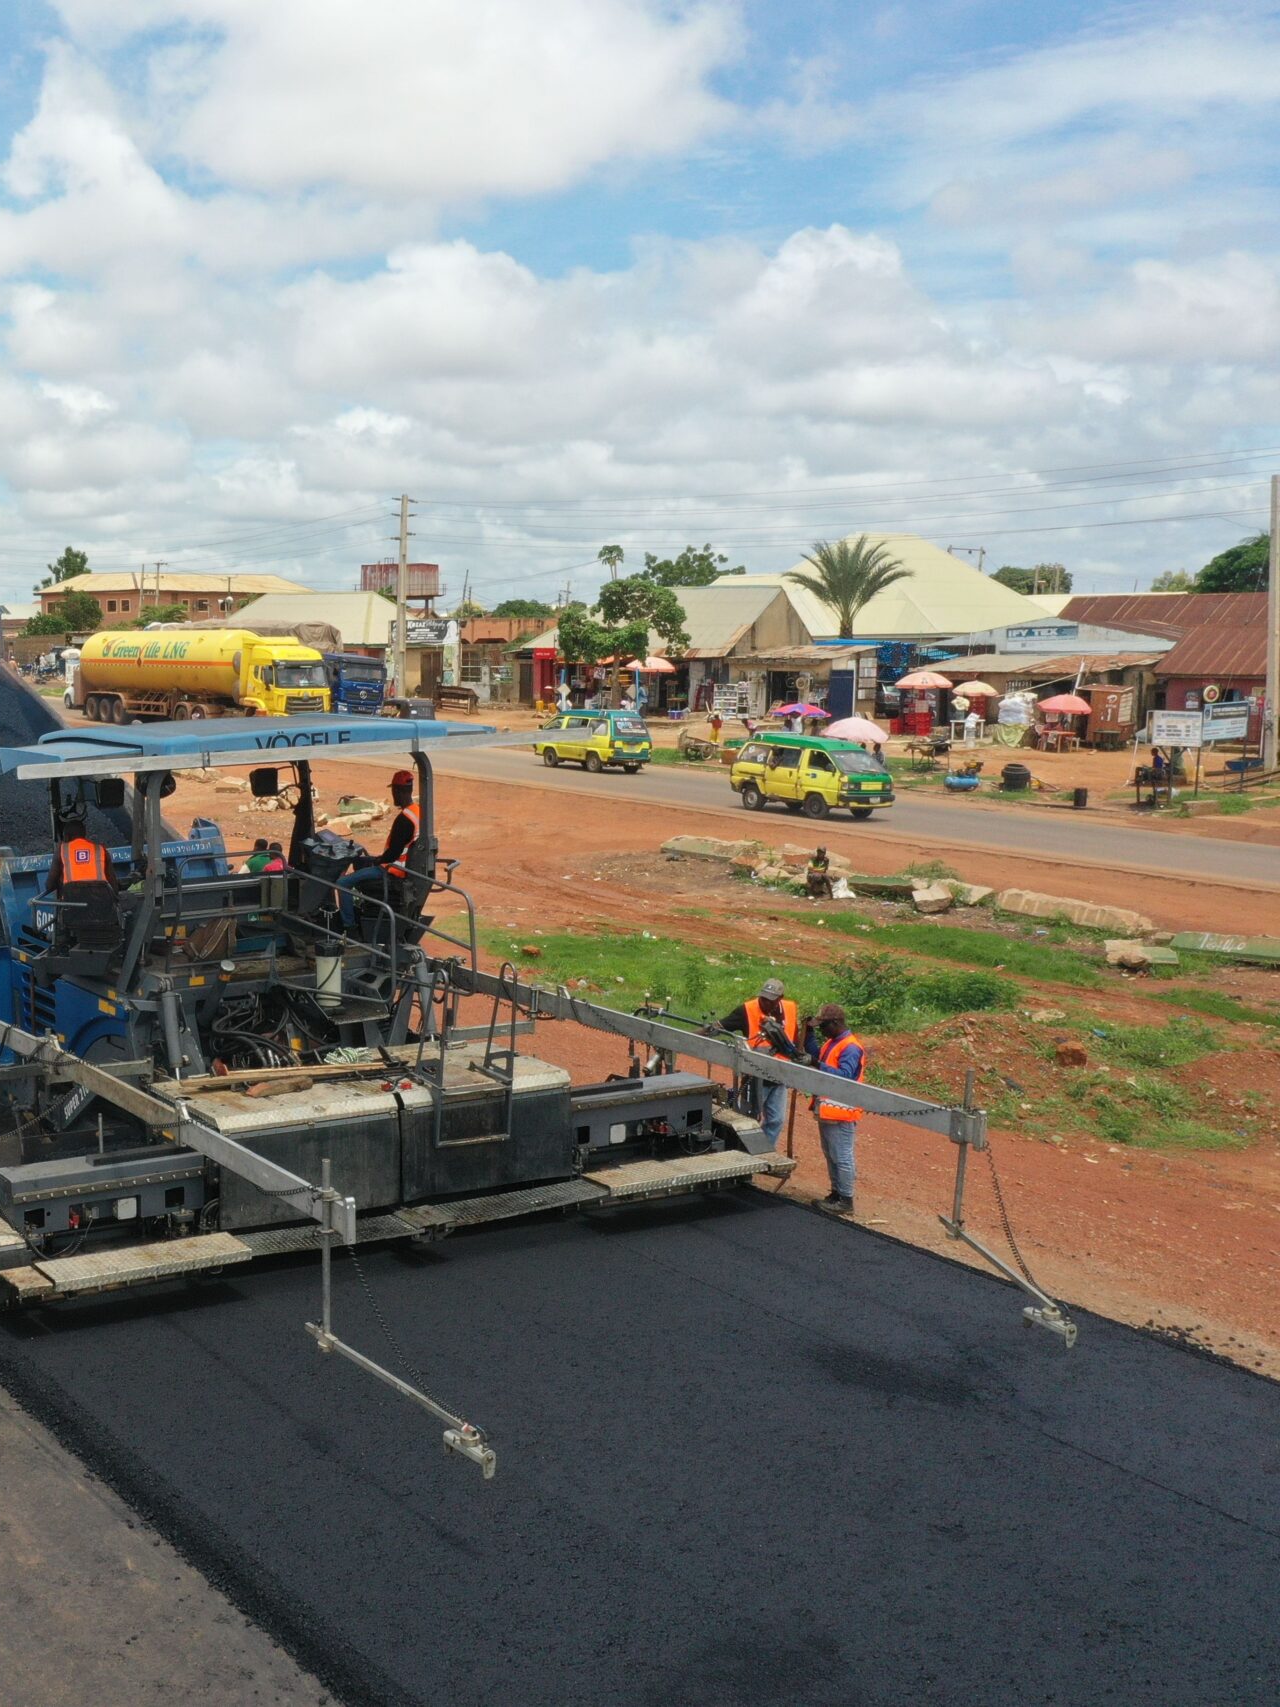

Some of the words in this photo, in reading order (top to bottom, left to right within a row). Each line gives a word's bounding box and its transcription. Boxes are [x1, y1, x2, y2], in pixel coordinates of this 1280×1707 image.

[162, 641, 190, 659] LNG
[78, 852, 87, 860] B
[64, 1094, 80, 1120] SUPER
